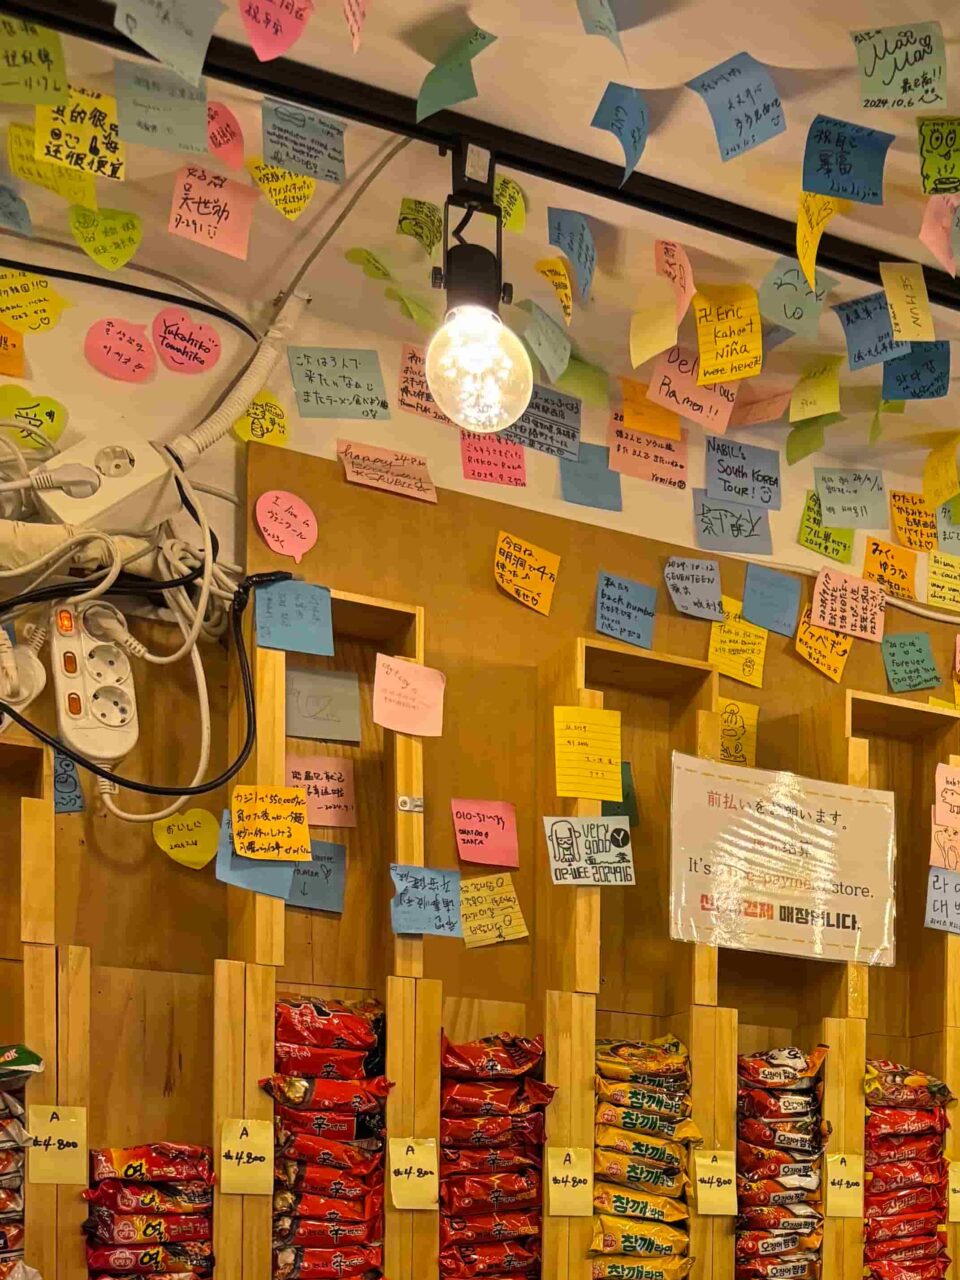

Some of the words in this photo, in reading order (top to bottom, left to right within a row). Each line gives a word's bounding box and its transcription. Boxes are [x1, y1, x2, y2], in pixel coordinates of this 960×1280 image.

[582, 823, 609, 839] very
[688, 857, 712, 876] It's
[831, 880, 874, 899] store.
[50, 1111, 60, 1123] A
[239, 1127, 249, 1140] A
[405, 1144, 416, 1156] A
[563, 1152, 572, 1165] A
[710, 1154, 719, 1165] A
[839, 1157, 847, 1167] A
[621, 1234, 673, 1254] 참깨라면
[607, 1264, 664, 1280] 참깨라면
